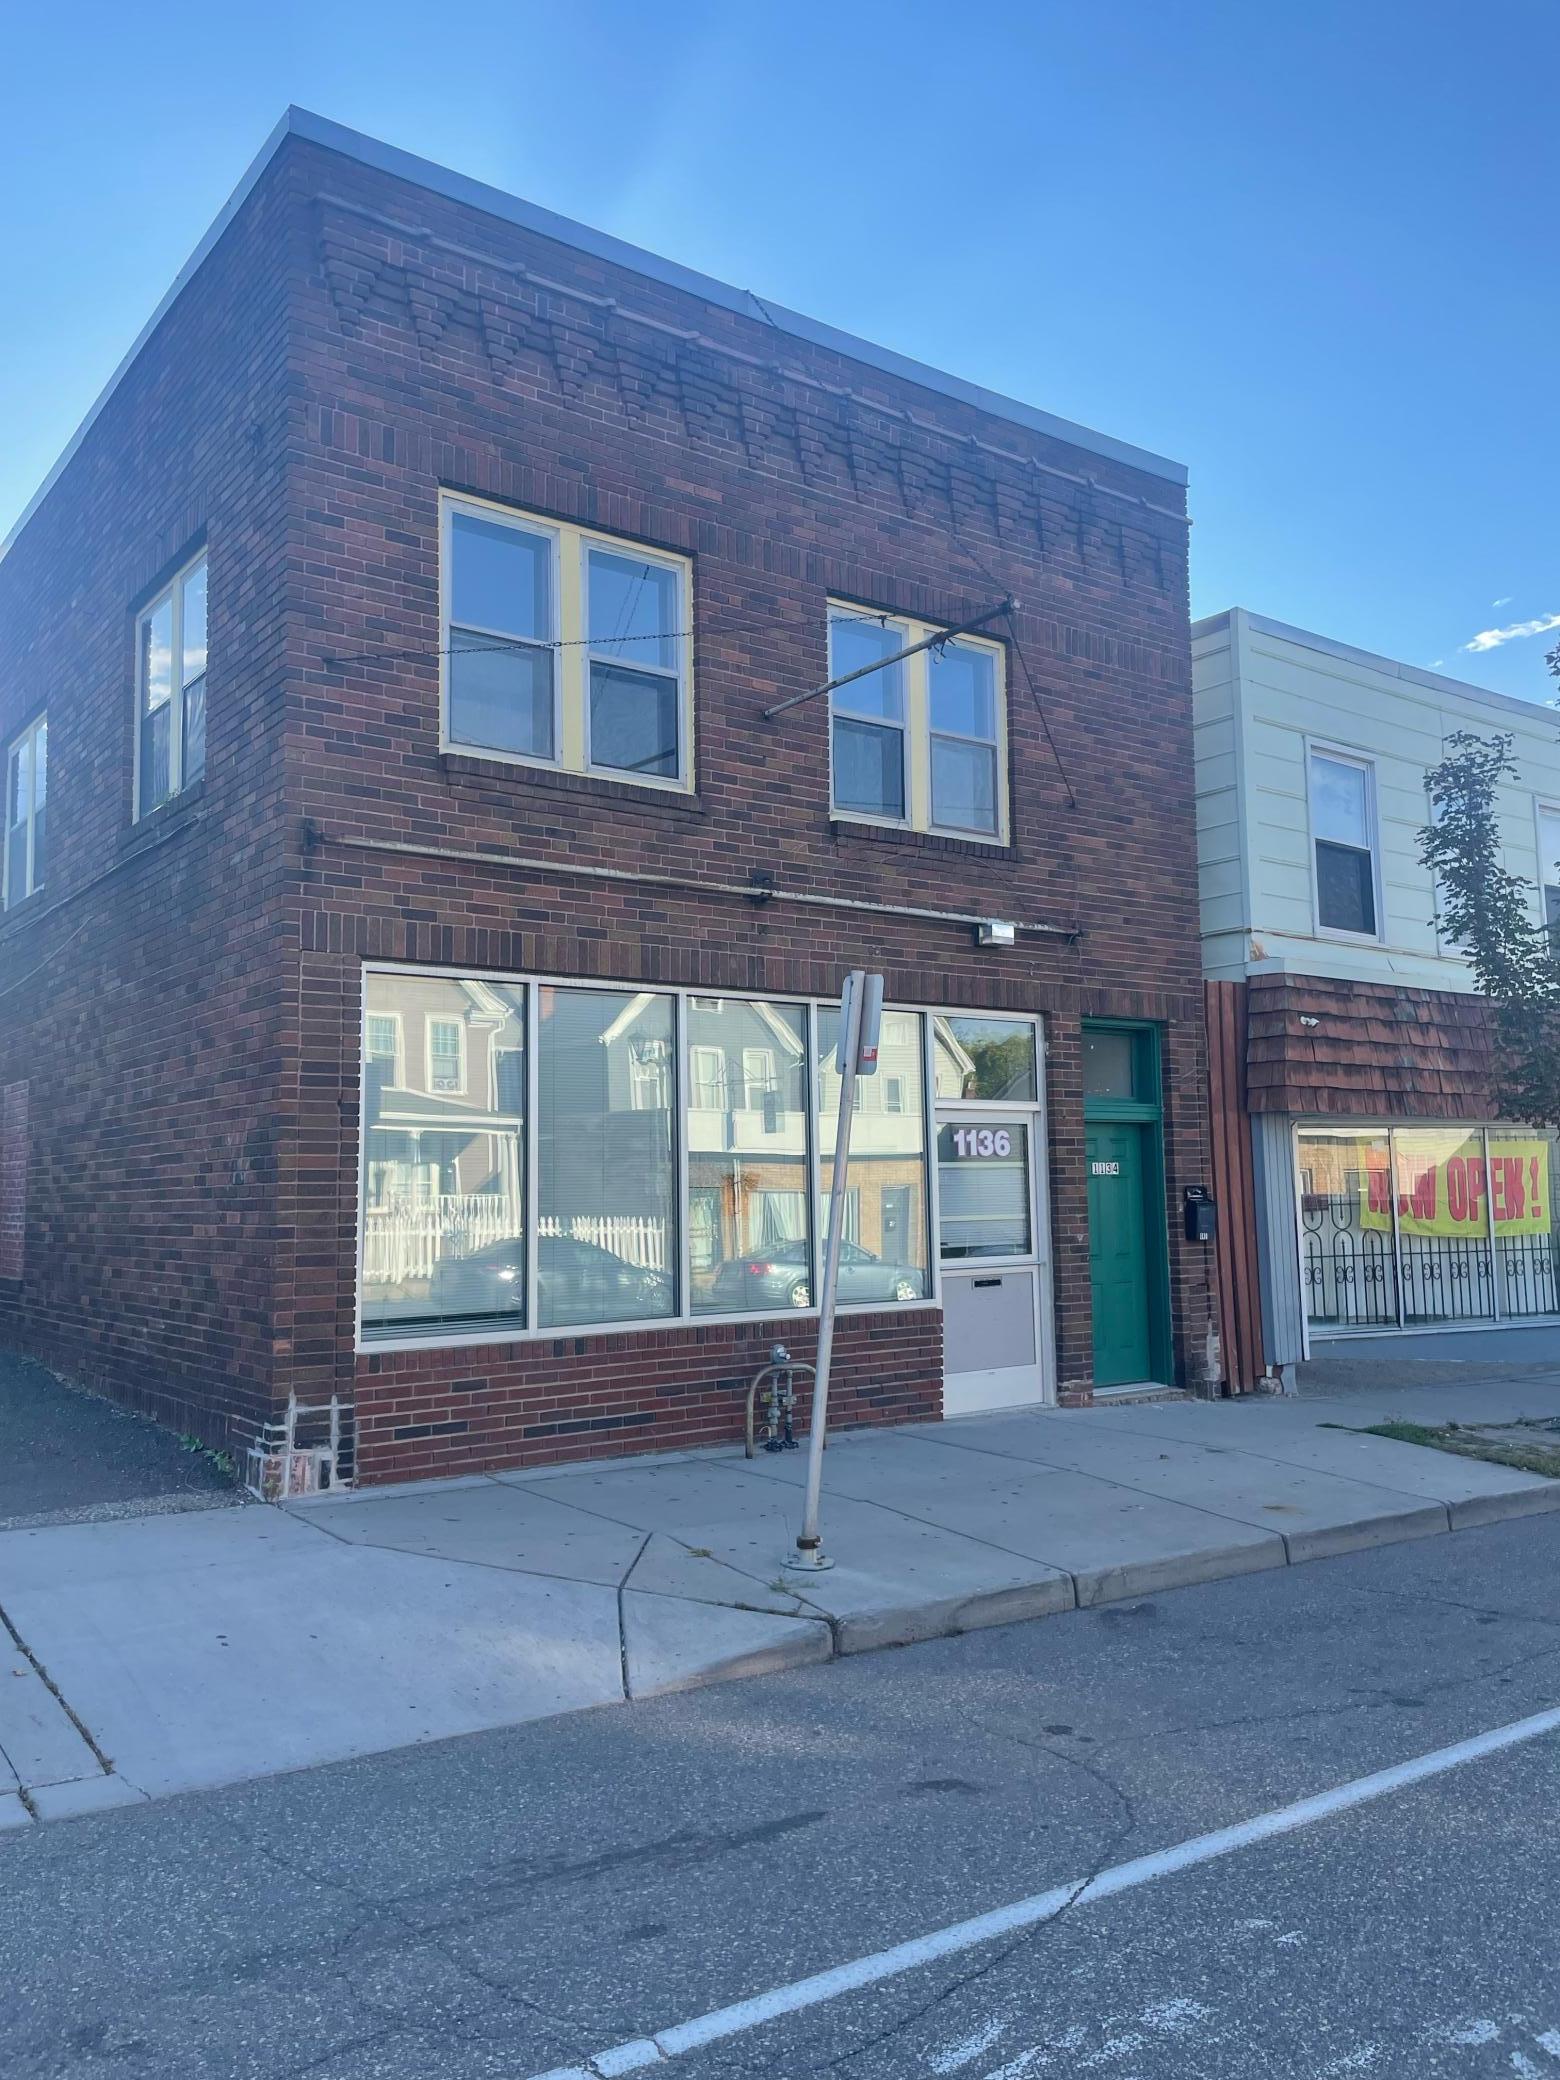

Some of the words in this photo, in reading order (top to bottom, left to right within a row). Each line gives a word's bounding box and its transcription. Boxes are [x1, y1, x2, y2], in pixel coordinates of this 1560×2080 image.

[953, 1129, 1011, 1157] 1136
[1092, 1162, 1119, 1174] 1134
[1446, 1156, 1542, 1221] OPEN!
